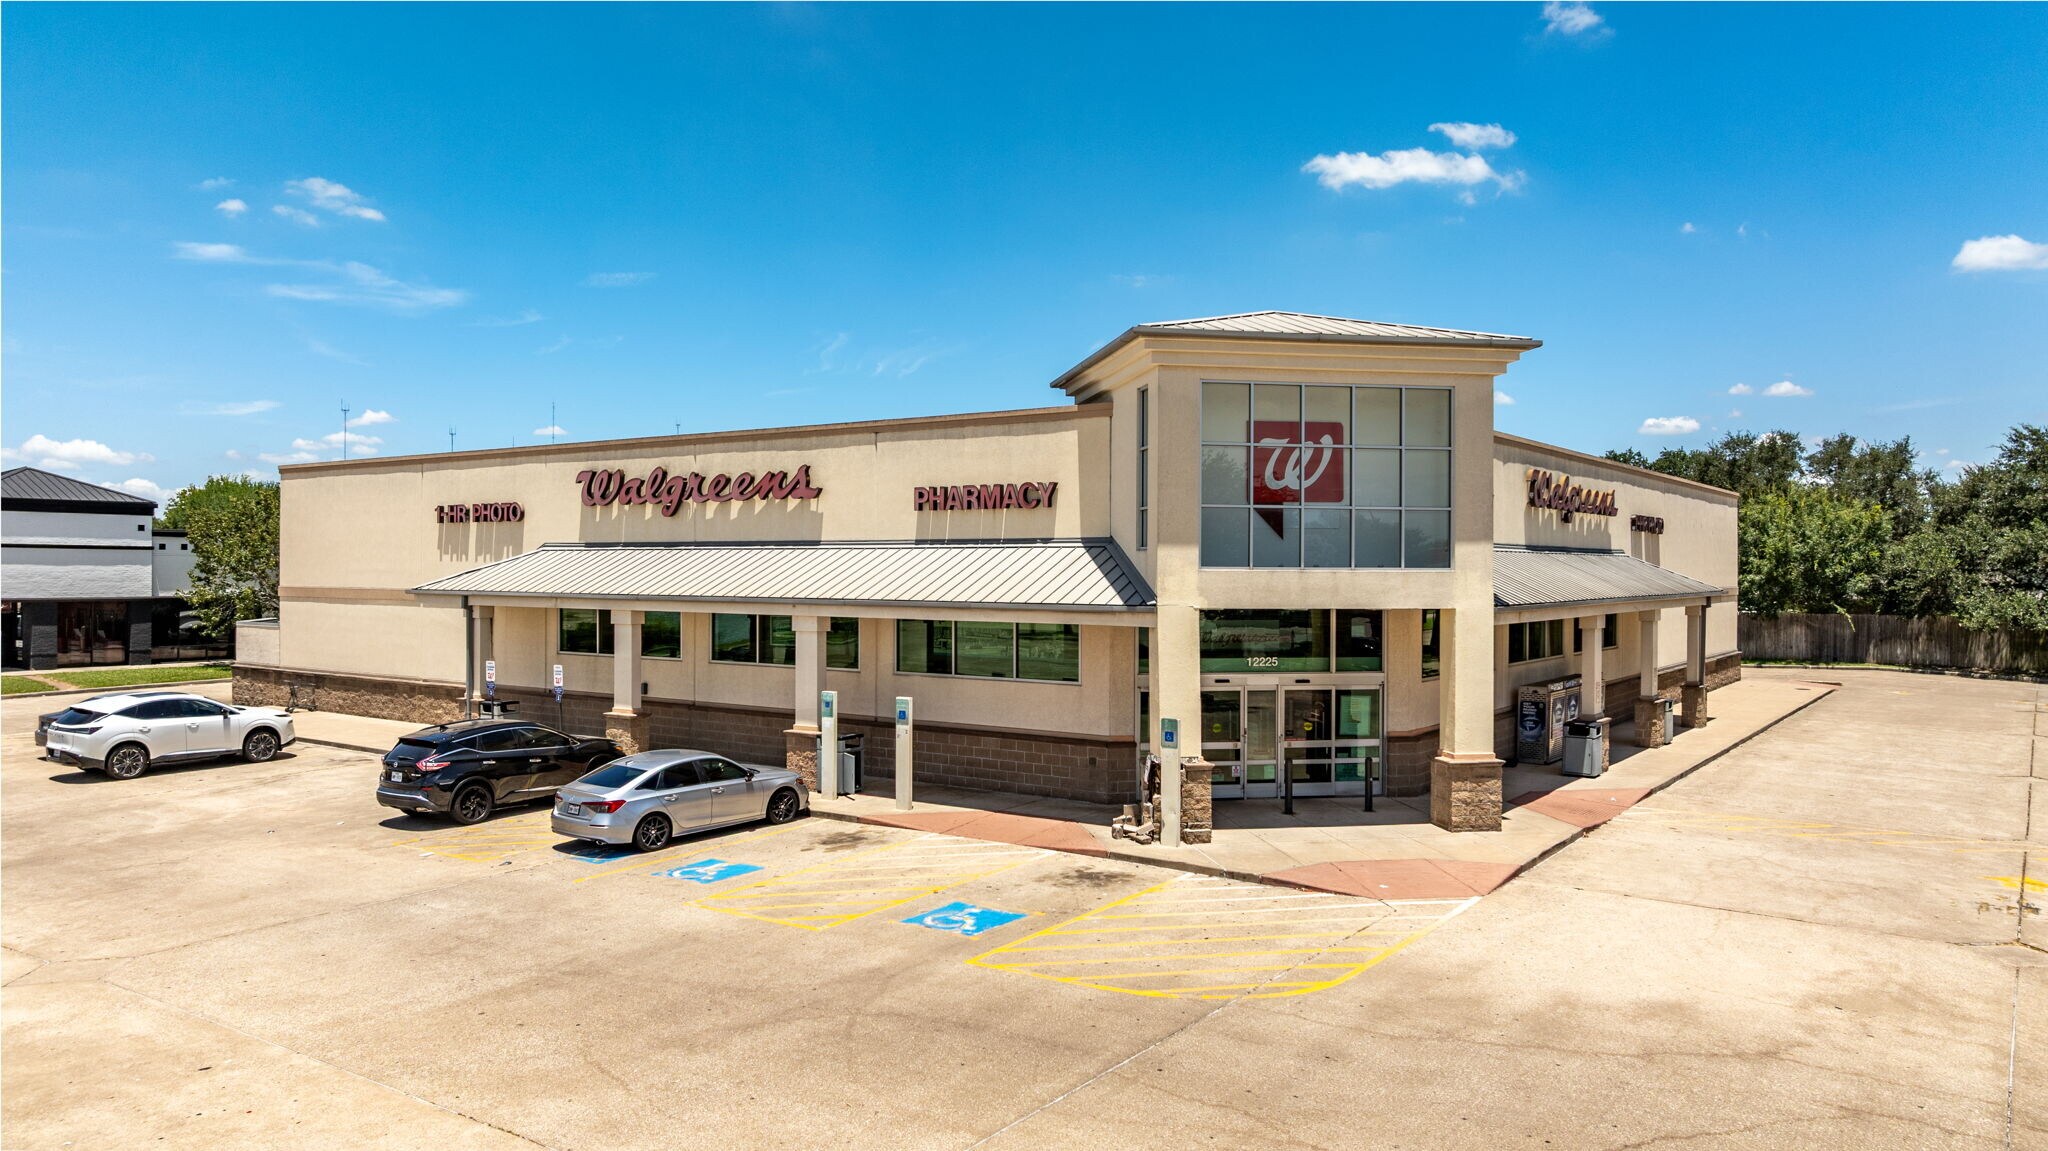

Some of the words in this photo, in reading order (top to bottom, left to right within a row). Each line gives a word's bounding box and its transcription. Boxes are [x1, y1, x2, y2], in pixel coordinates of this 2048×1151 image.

[576, 464, 823, 517] Walgreens
[914, 481, 1058, 511] PHARMACY
[1526, 469, 1618, 523] Walgreens
[435, 504, 470, 523] 1-HR
[472, 502, 525, 523] PHOTO
[1246, 657, 1279, 667] 12225
